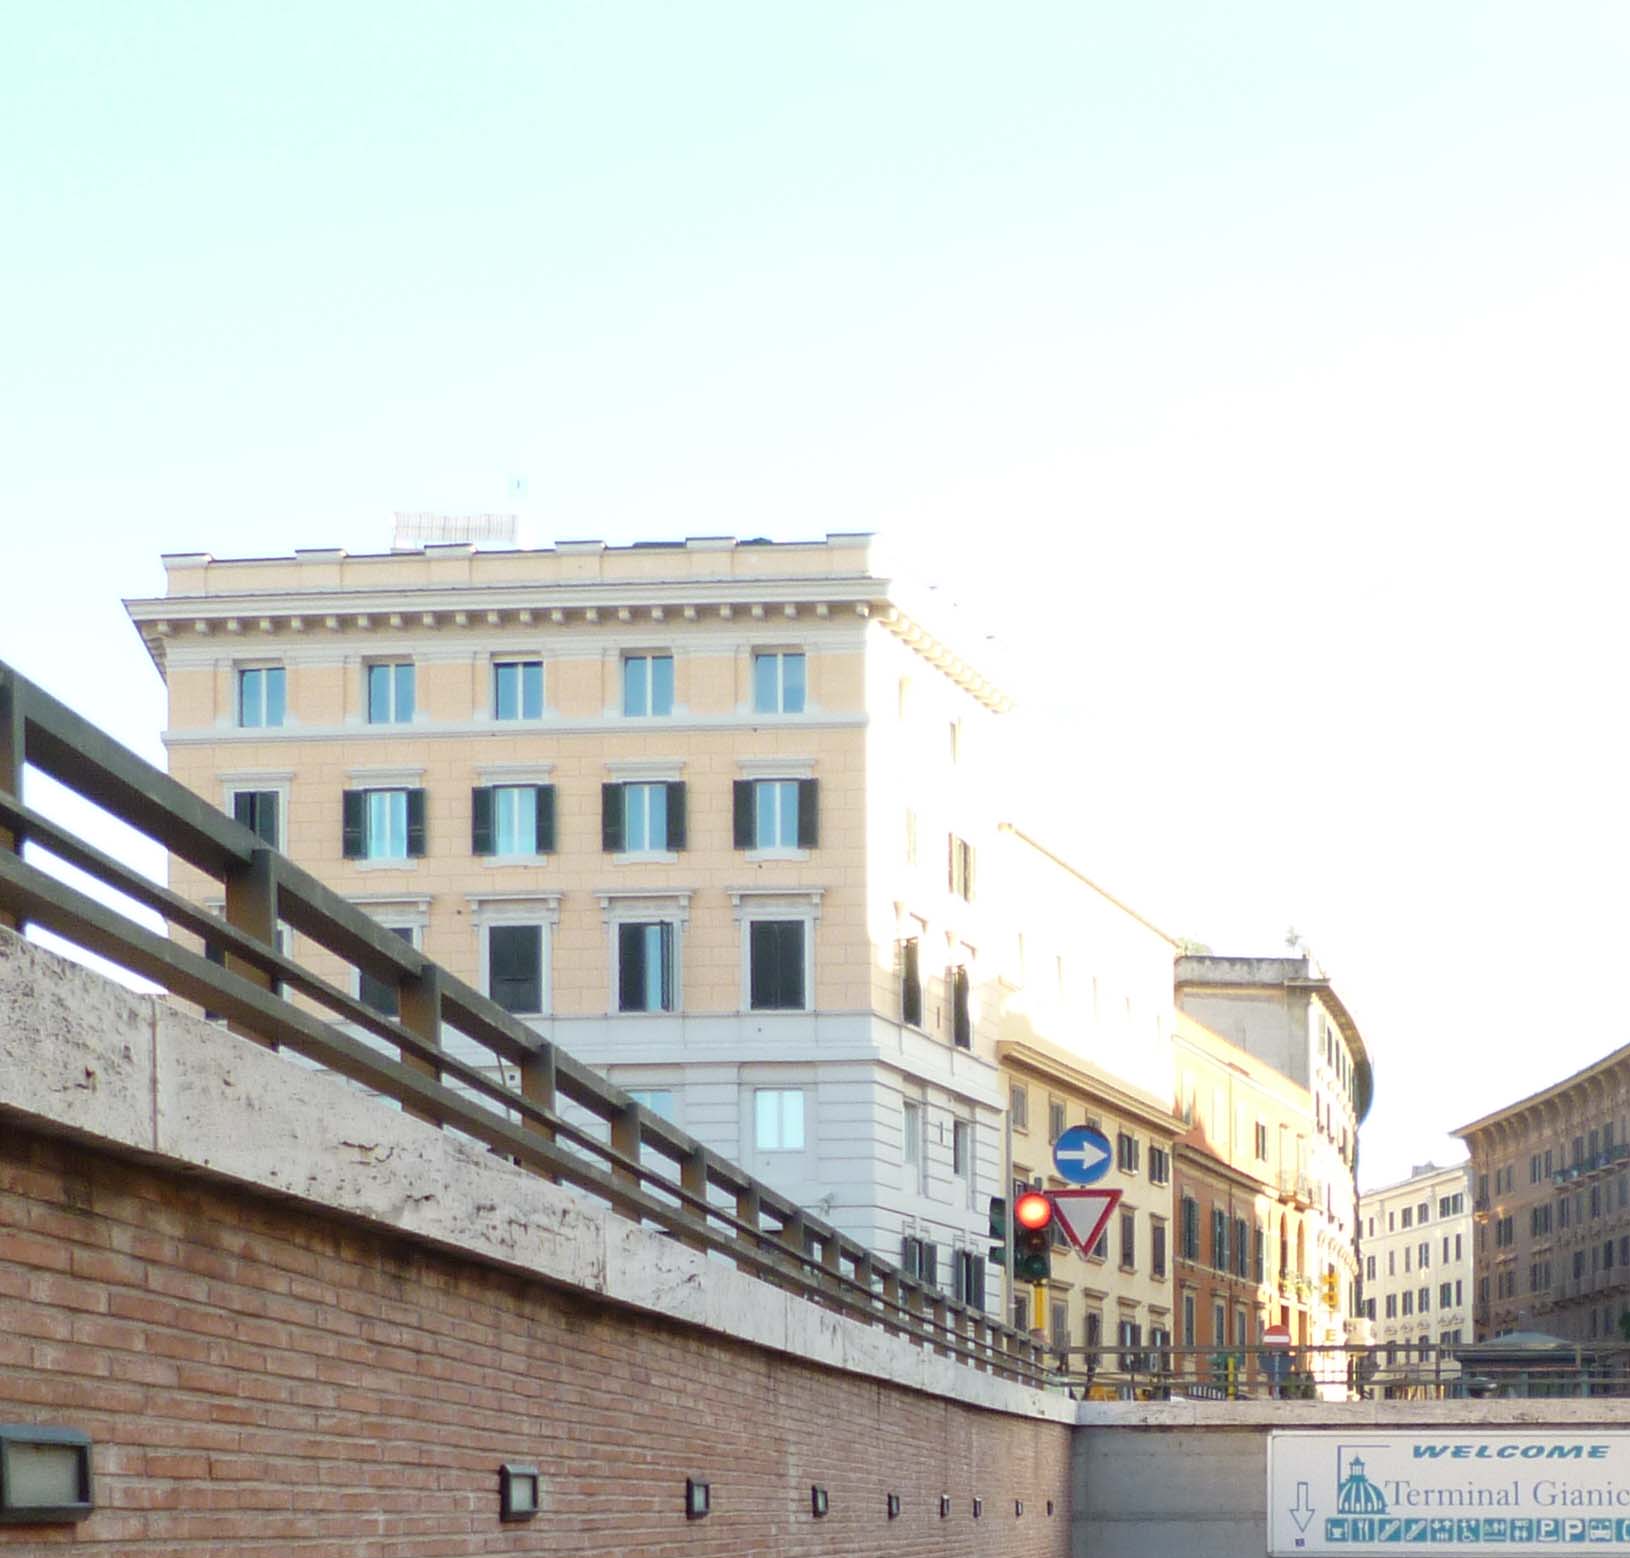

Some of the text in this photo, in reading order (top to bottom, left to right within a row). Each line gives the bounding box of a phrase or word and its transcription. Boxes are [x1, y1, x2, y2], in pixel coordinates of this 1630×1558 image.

[1412, 1444, 1611, 1459] WELCOME
[1384, 1479, 1519, 1507] Terminal
[1541, 1520, 1554, 1537] P
[1564, 1519, 1583, 1541] P
